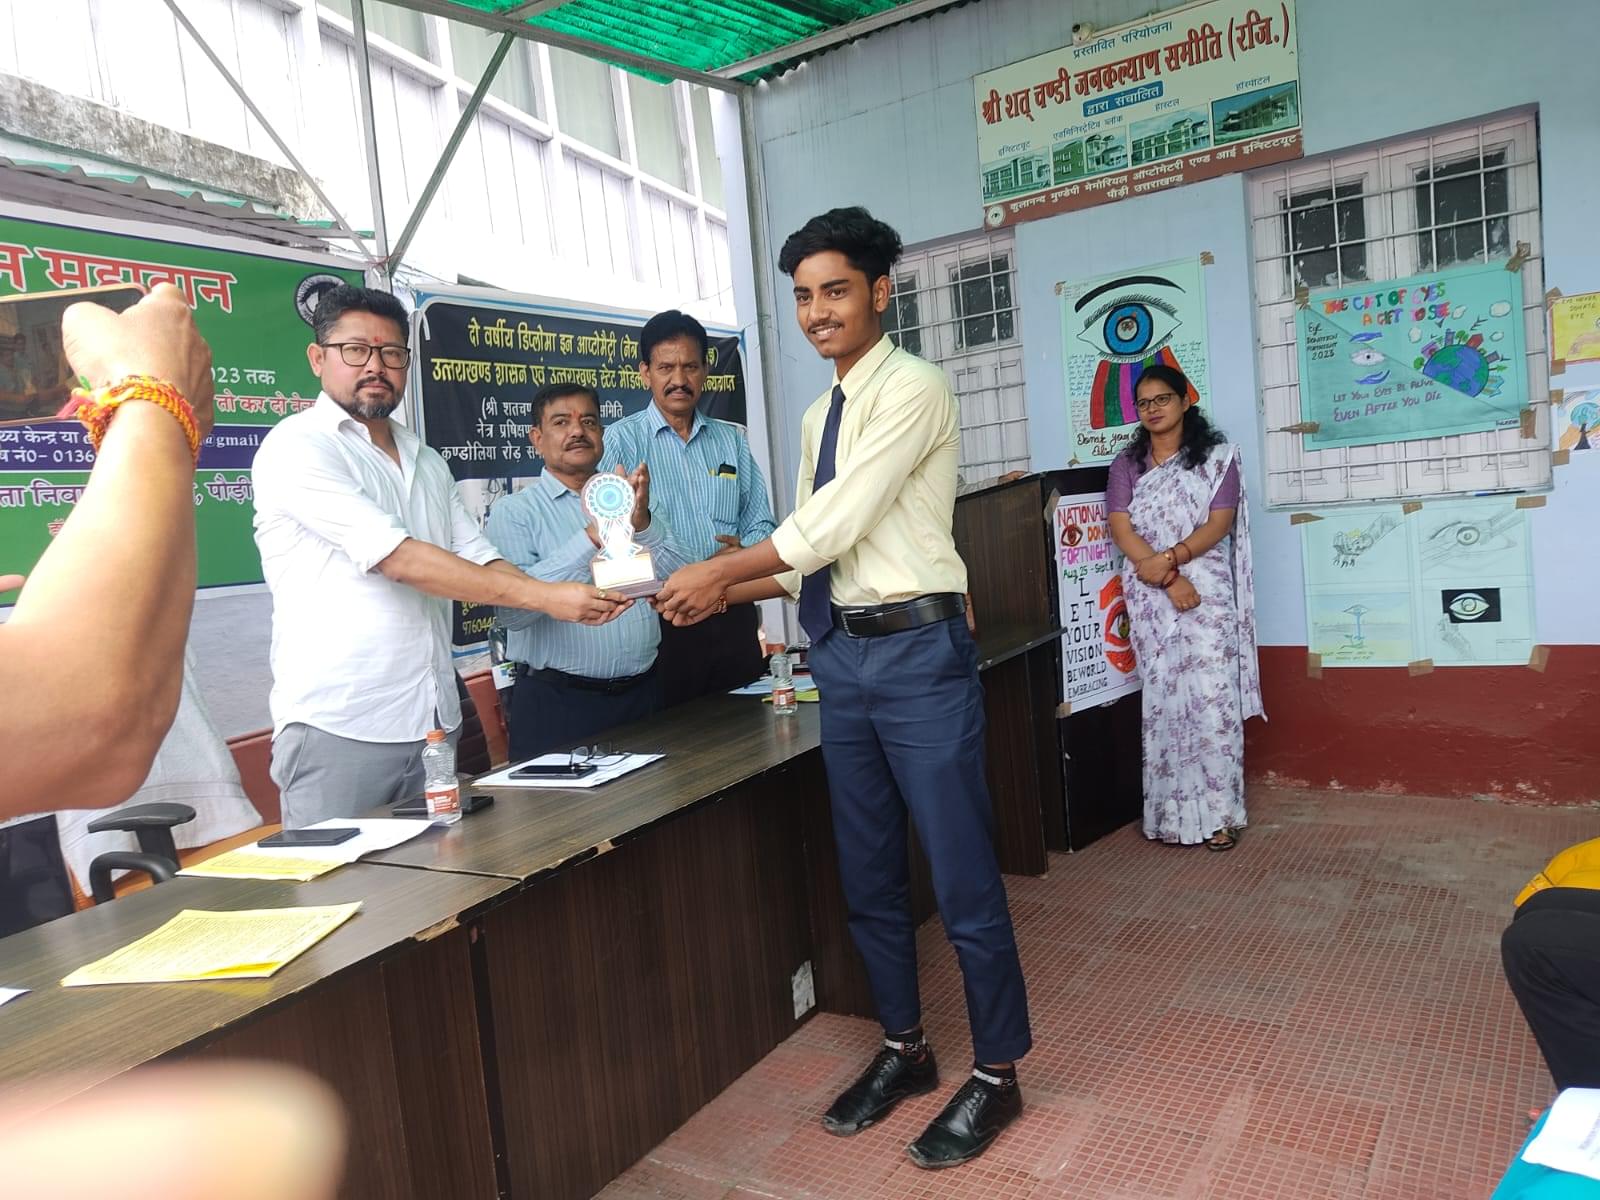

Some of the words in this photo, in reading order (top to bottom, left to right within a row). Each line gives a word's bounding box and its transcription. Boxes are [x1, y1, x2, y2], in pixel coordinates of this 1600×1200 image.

[1073, 37, 1116, 59] प्रस्तावित
[1121, 21, 1172, 45] परियोजना
[982, 88, 1002, 124] श्री
[1005, 88, 1034, 121] शत्
[1034, 67, 1071, 108] चण्डी
[1073, 49, 1161, 96] जनकल्याण
[1164, 22, 1223, 72] समीति
[1227, 2, 1290, 62] (रजि.)
[1087, 100, 1109, 116] द्वारा
[1115, 85, 1160, 106] संचालित
[1216, 147, 1236, 161] आई
[1323, 298, 1349, 315] THE
[1387, 288, 1408, 306] OF
[1363, 313, 1373, 326] A
[468, 317, 480, 347] दो
[483, 318, 515, 349] वर्षीय
[518, 321, 558, 352] डिप्लोमा
[559, 333, 574, 355] इन
[244, 368, 276, 385] तक
[430, 357, 492, 384] उत्तराखण्ड
[493, 362, 528, 386] शासन
[529, 356, 546, 387] एवं
[599, 363, 617, 390] स्टेट
[214, 388, 237, 413] तो
[238, 395, 267, 414] कर
[268, 390, 288, 416] दो
[1333, 407, 1360, 423] EVEN
[22, 425, 58, 445] केन्द्र
[58, 431, 80, 444] या
[476, 418, 494, 438] नेत्र
[440, 440, 497, 460] कण्डोलिया
[501, 440, 521, 462] रोड़
[1057, 505, 1107, 527] NATIONAL
[1061, 543, 1112, 566] FORTNIGHT
[1066, 622, 1102, 646] YOUR
[1066, 643, 1103, 665] VISION
